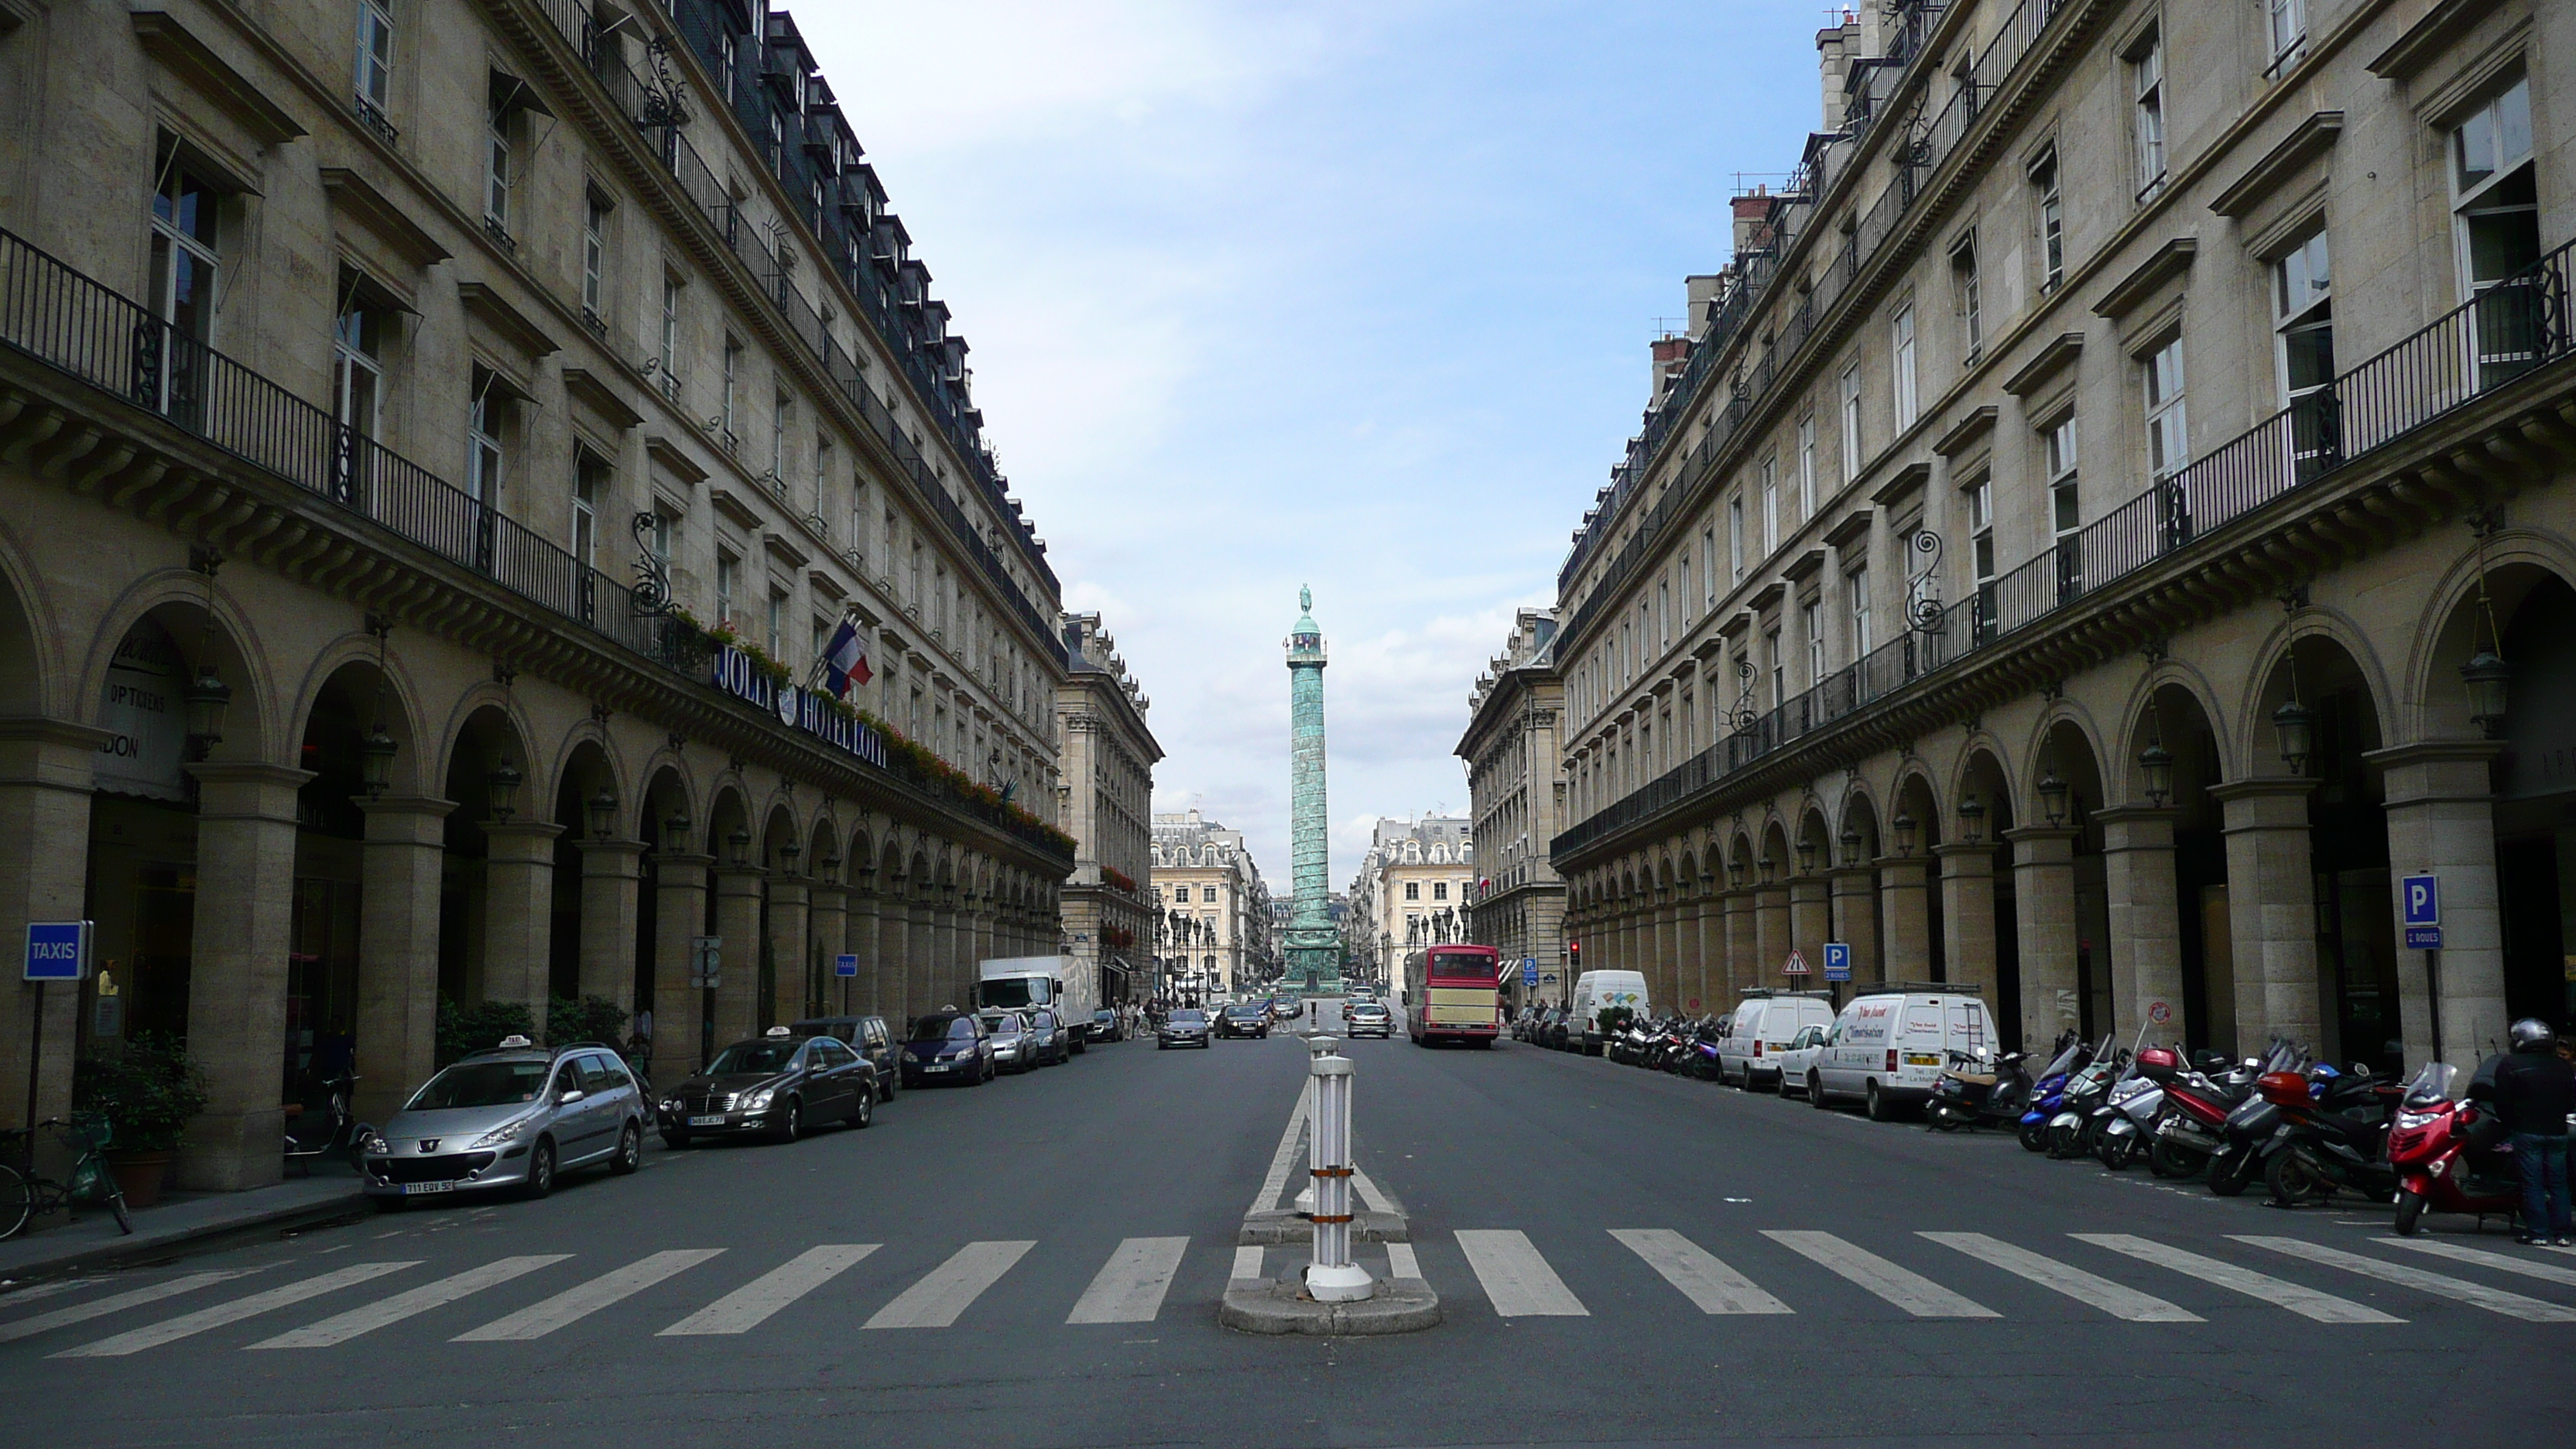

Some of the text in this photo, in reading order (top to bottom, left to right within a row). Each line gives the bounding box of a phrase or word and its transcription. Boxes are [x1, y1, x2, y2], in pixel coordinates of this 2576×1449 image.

[804, 690, 850, 750] HOTEL
[2411, 885, 2427, 915] P
[2415, 932, 2439, 943] ROUES
[32, 942, 76, 959] TAXIS
[1831, 948, 1842, 964] P
[407, 1184, 421, 1193] 711
[442, 1181, 451, 1190] 92
